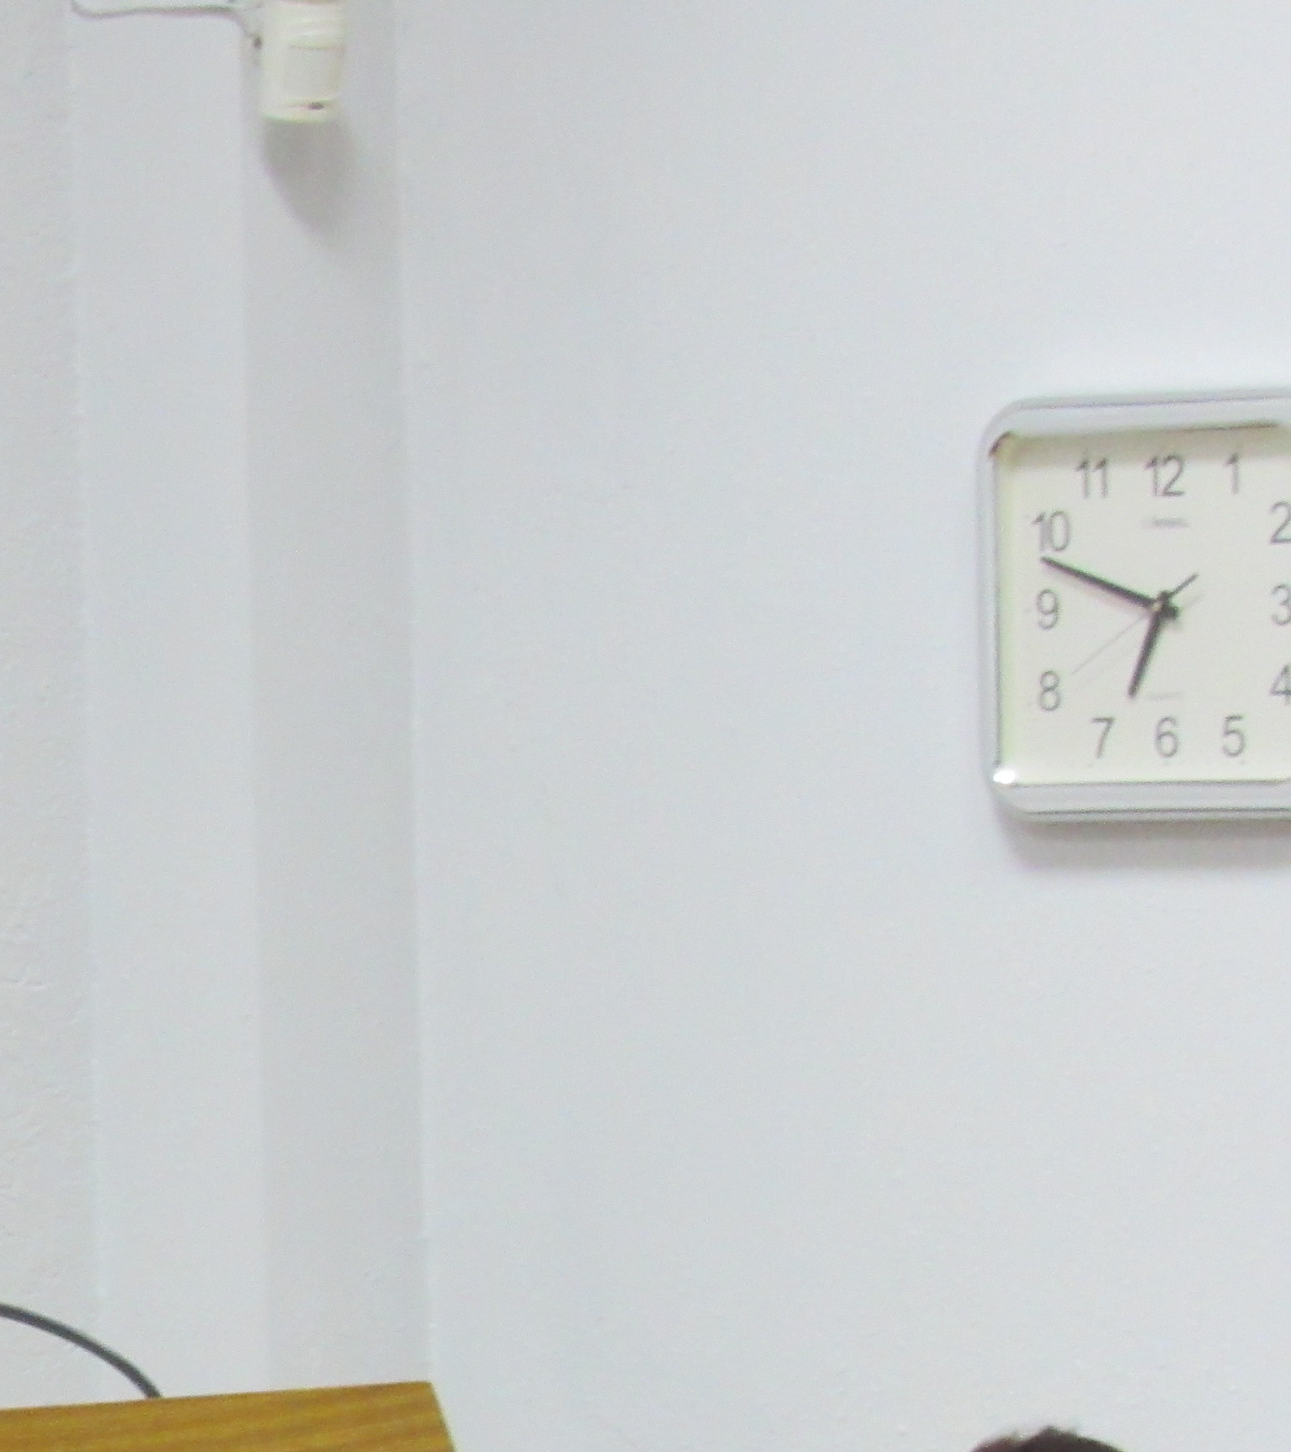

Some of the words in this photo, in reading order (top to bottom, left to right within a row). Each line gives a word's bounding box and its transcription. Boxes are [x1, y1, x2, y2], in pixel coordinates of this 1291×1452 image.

[1075, 457, 1109, 499] 11
[1143, 454, 1185, 497] 12
[1224, 452, 1241, 495] 1
[1032, 510, 1071, 552] 10
[1269, 501, 1291, 545] 2
[1036, 589, 1060, 631] 9
[1270, 584, 1291, 627] 3
[1038, 670, 1062, 713] 8
[1269, 664, 1291, 706] 4
[1091, 717, 1116, 759] 7
[1155, 716, 1180, 759] 6
[1222, 715, 1247, 758] 5
